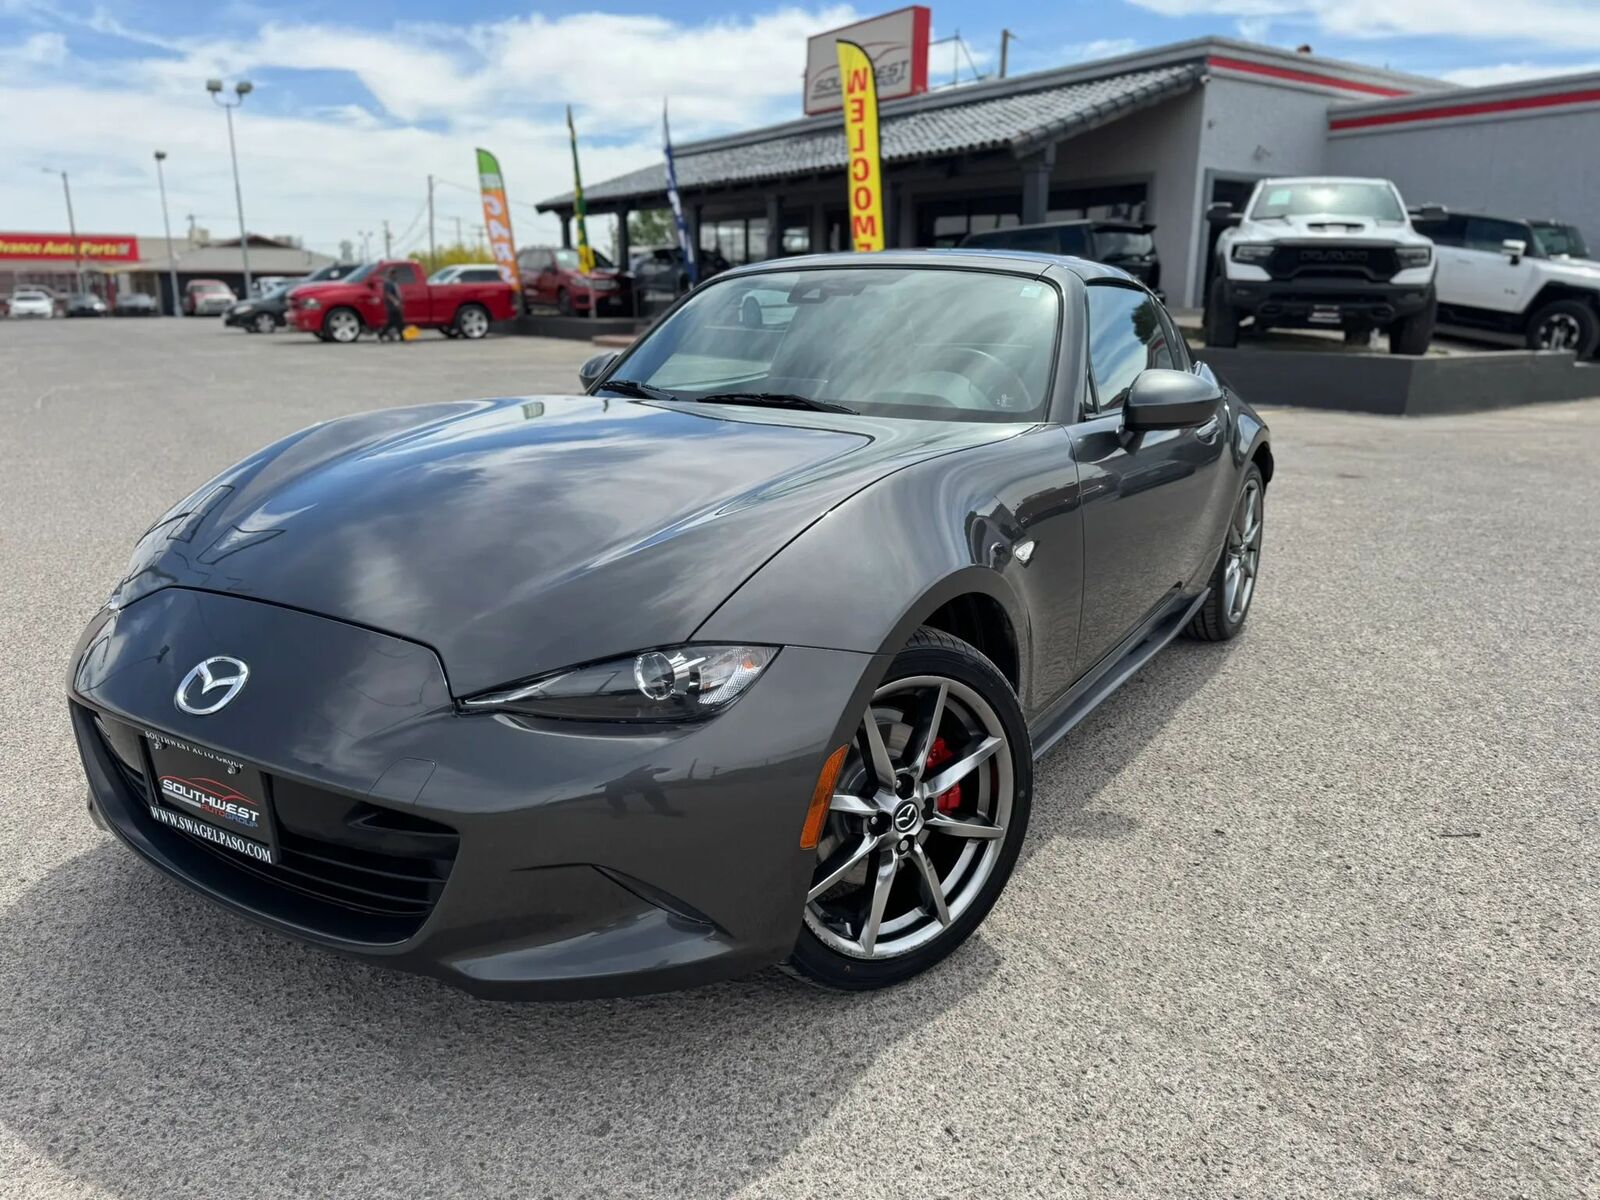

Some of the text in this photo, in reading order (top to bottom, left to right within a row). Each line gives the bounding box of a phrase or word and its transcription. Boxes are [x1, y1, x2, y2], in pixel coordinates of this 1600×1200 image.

[80, 241, 117, 256] Parts
[162, 779, 259, 822] SOUTHWEST
[150, 805, 272, 864] WWW.SWAGELPASO.COM
